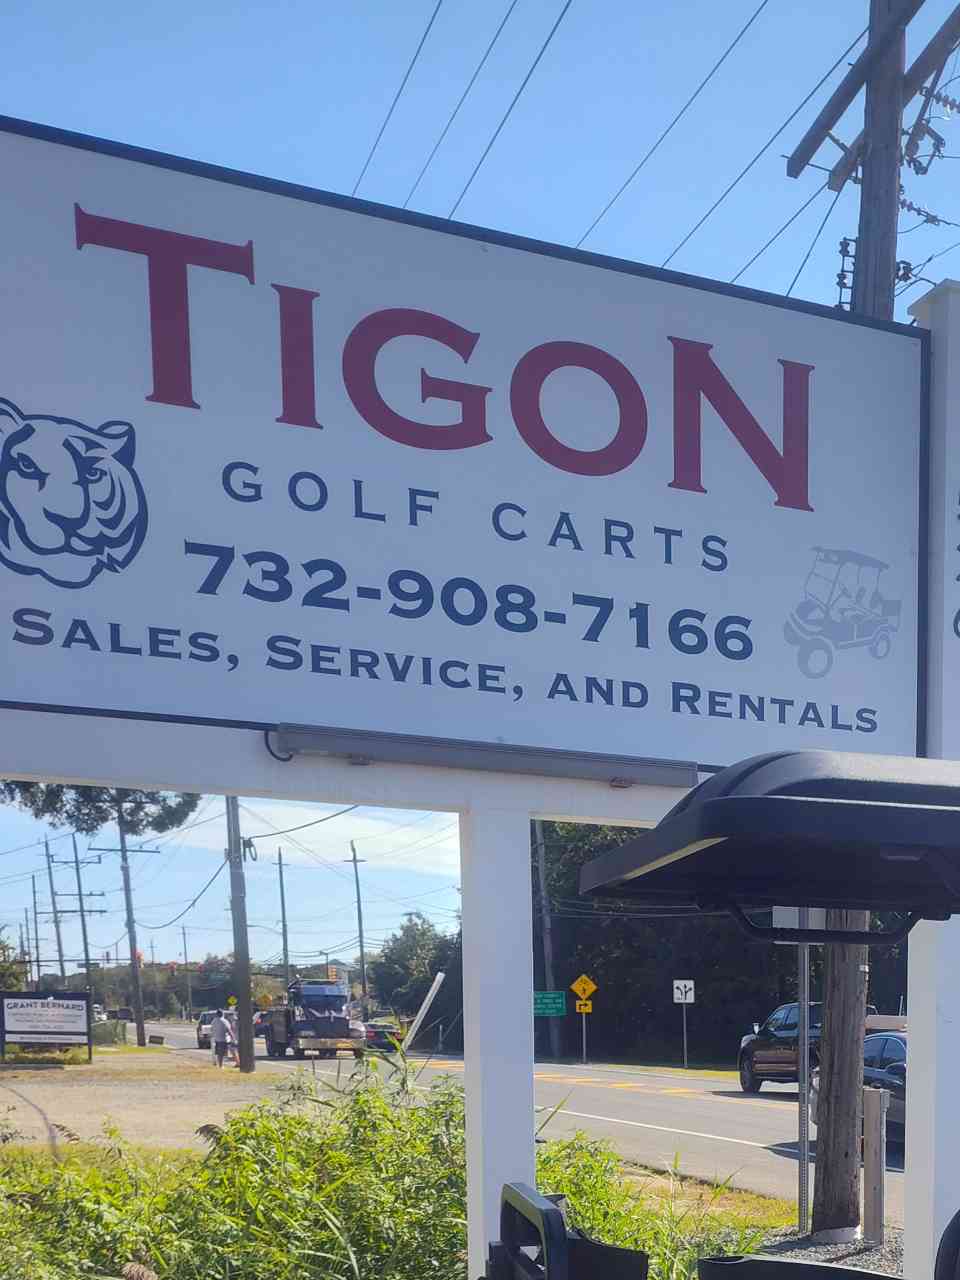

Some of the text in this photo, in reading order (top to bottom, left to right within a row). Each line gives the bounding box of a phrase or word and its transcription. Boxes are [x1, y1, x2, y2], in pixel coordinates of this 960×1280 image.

[74, 203, 815, 512] TIGON
[221, 460, 730, 573] GOLF CARTS
[183, 540, 755, 662] 732-908-7166
[11, 608, 880, 734] SALES, SERVICE, AND RENTALS
